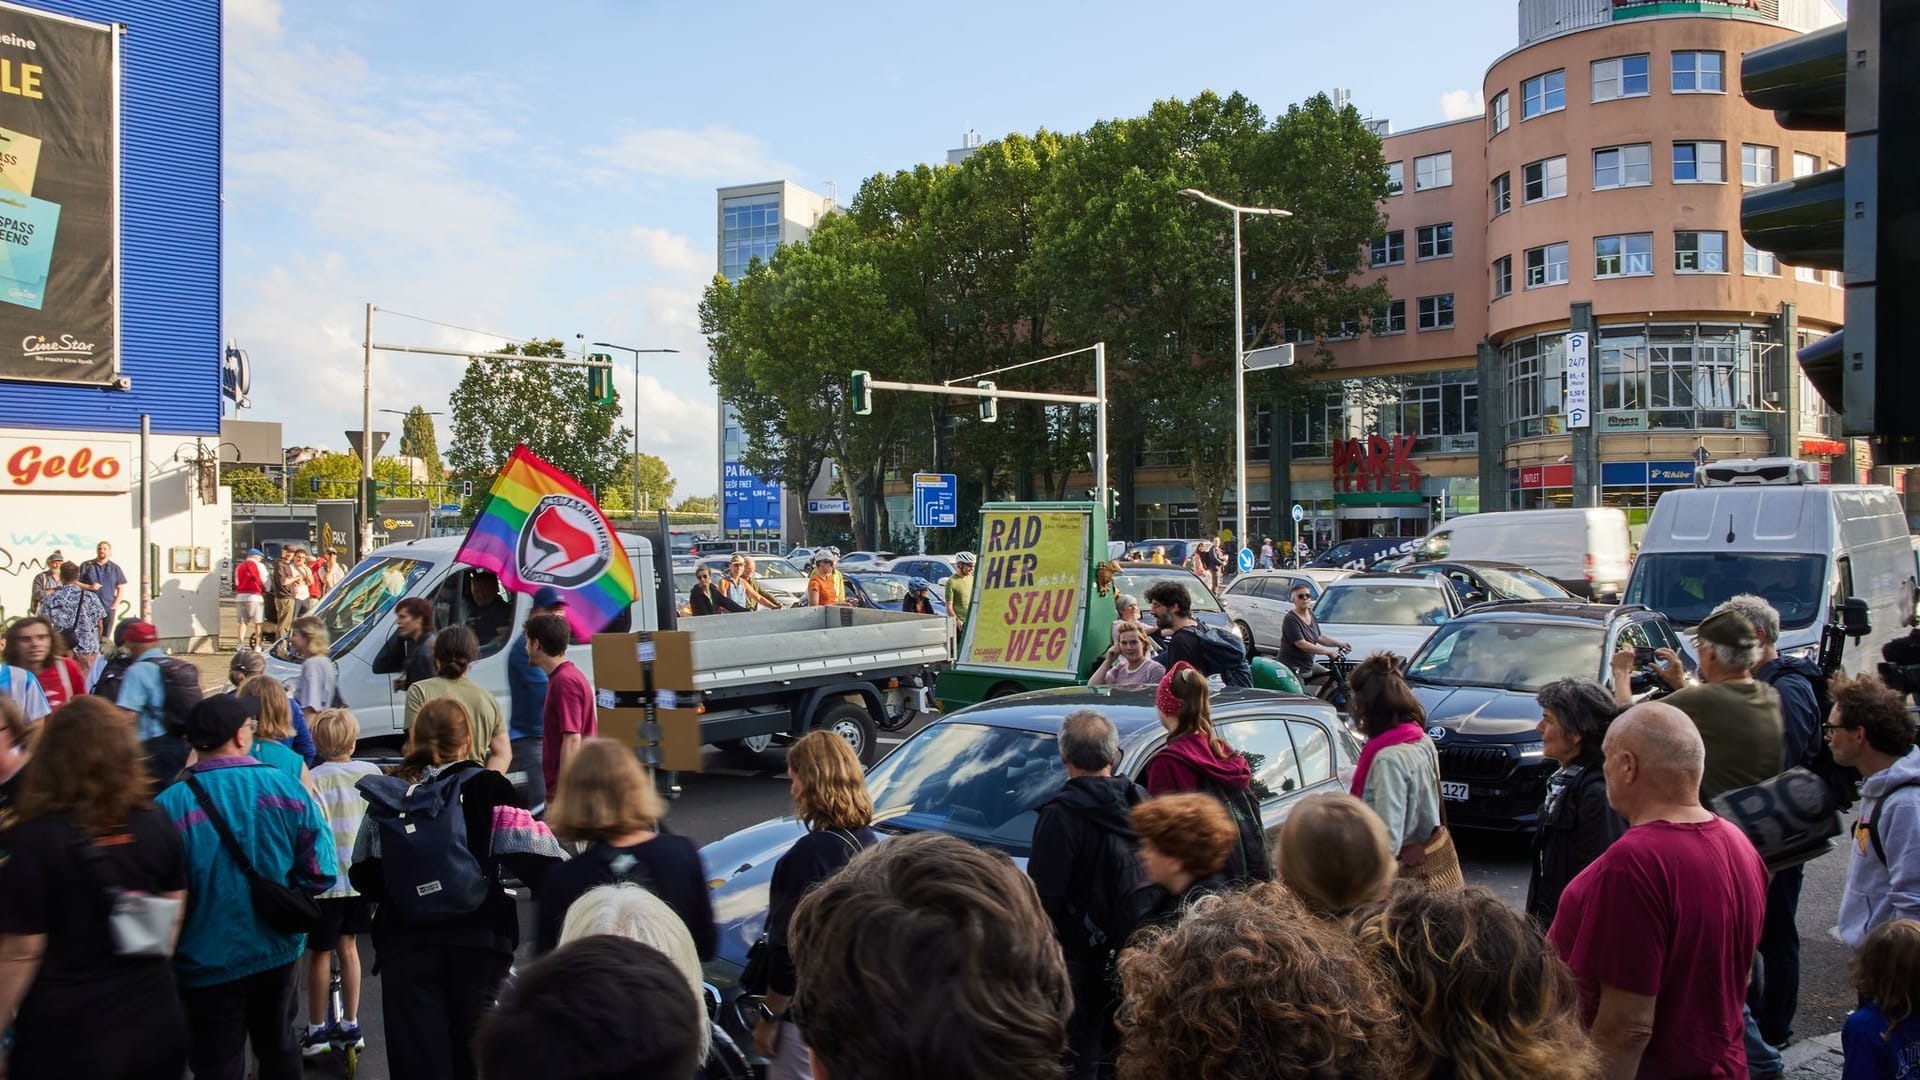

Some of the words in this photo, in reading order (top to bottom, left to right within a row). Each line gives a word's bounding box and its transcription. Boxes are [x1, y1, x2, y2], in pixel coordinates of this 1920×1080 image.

[0, 32, 37, 50] eine
[22, 334, 95, 352] CineStar
[1569, 357, 1585, 368] 24/7
[7, 446, 120, 486] Gelo
[1333, 432, 1421, 473] PARK
[1334, 474, 1423, 493] CENTER
[332, 531, 347, 545] PAX
[988, 515, 1042, 552] RAD
[984, 553, 1038, 590] HER
[1004, 588, 1074, 626] STAU
[1005, 627, 1067, 662] WEG
[1443, 783, 1467, 798] 127
